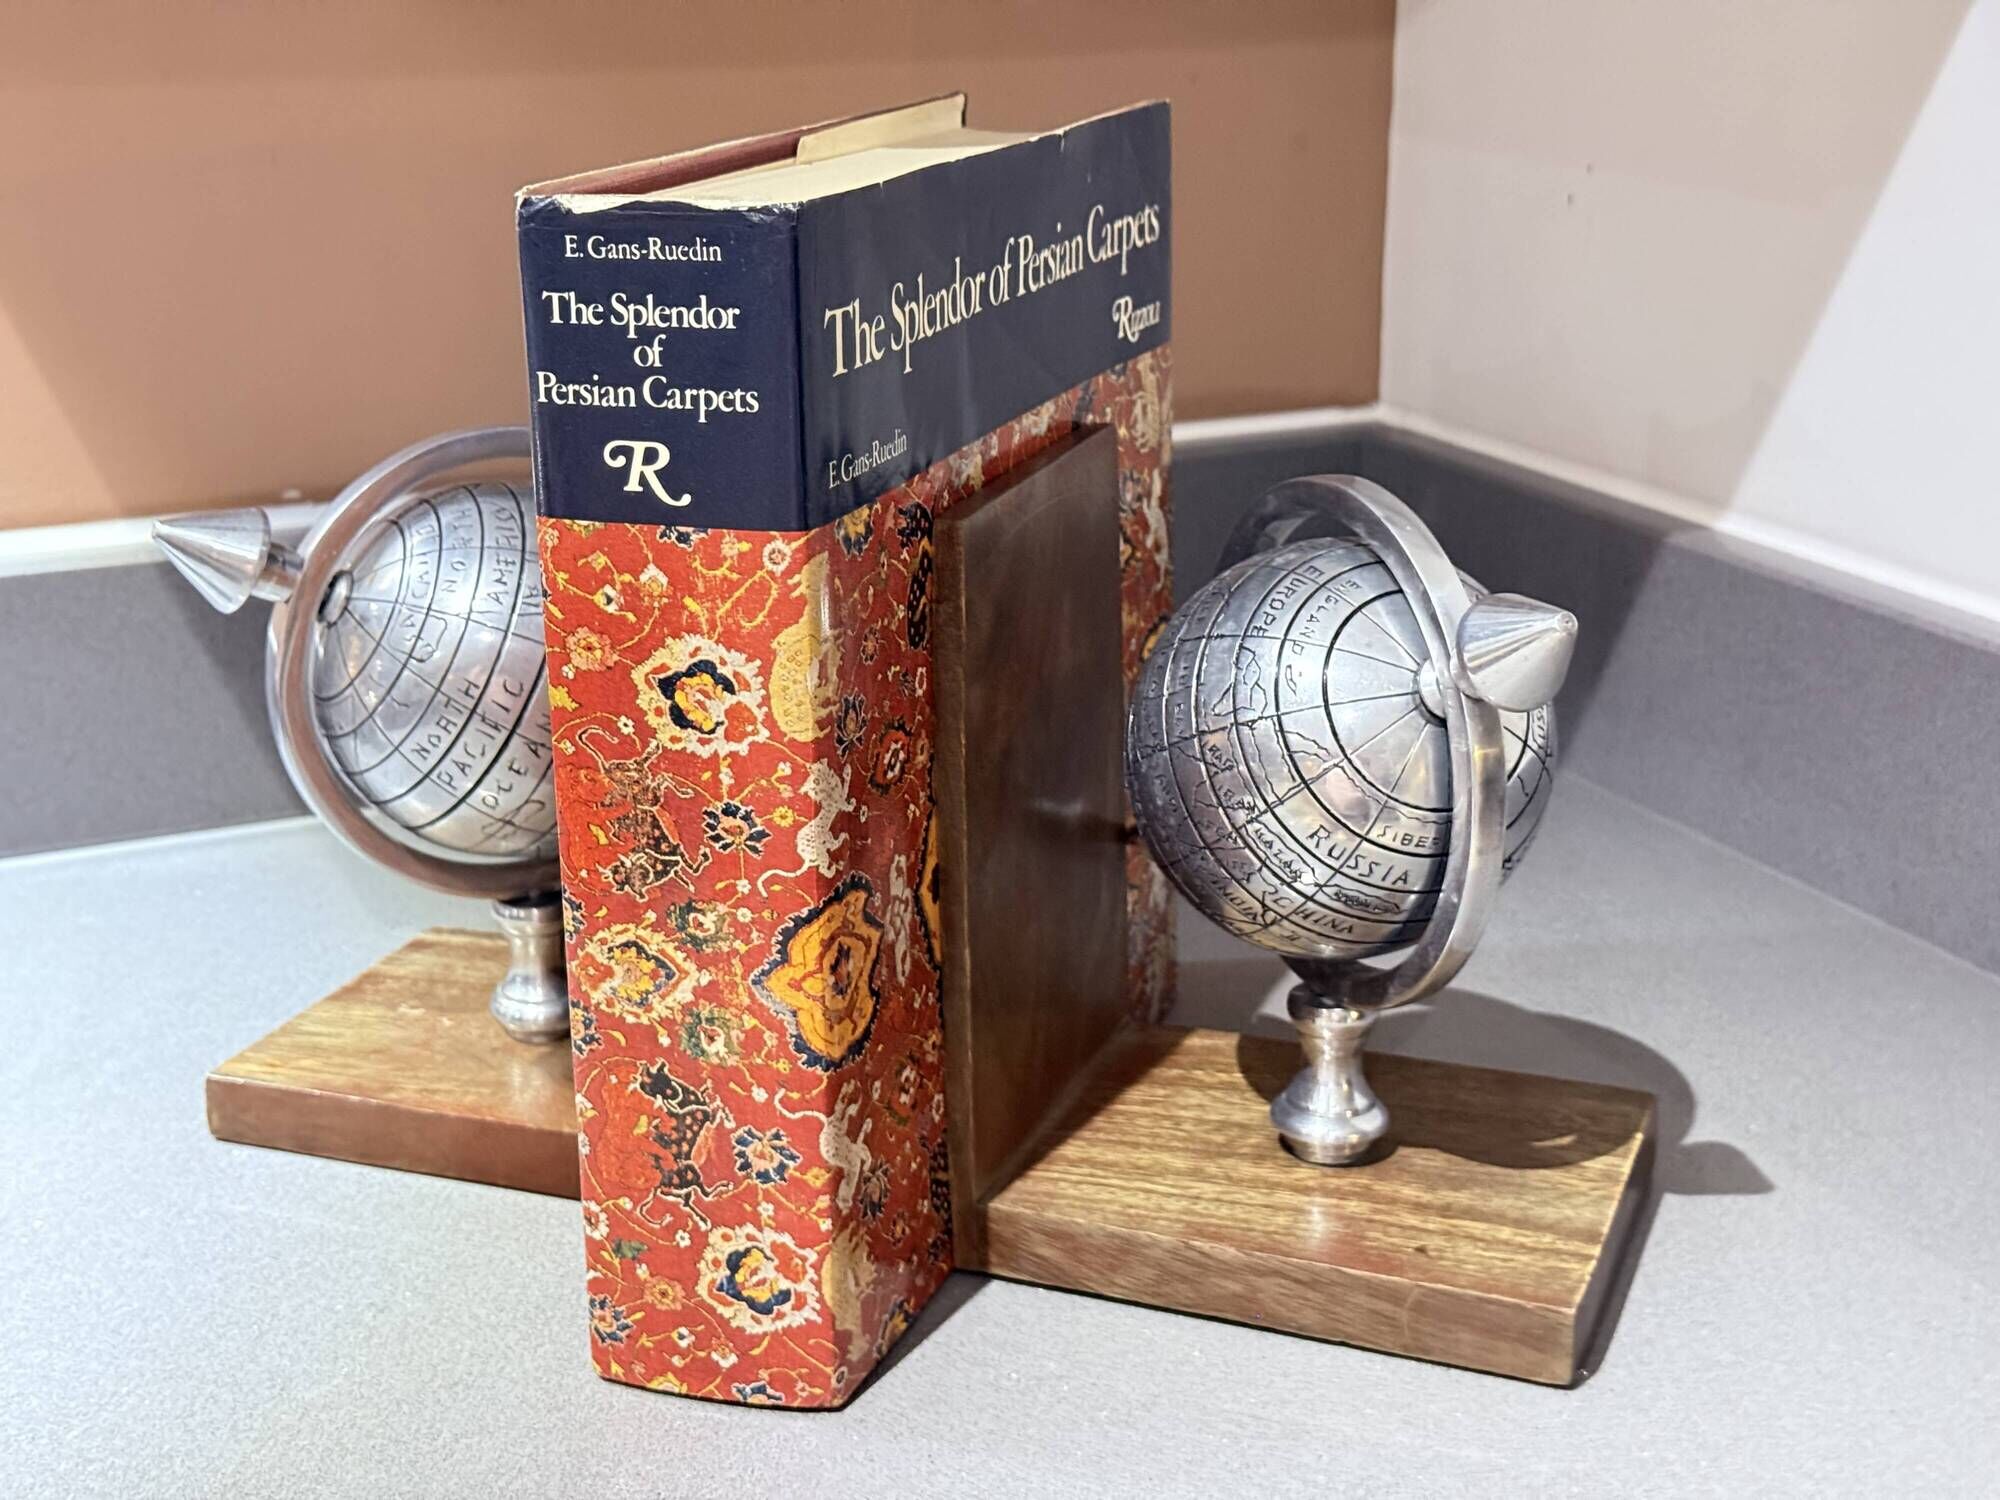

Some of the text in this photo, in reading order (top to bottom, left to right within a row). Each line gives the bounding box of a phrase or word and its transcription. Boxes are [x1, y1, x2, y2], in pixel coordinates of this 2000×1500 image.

[564, 235, 722, 262] E. Gans-Ruedin
[542, 290, 740, 339] The Splendor
[824, 204, 1160, 377] The Splendor of Persian Carpets
[633, 334, 666, 367] of
[536, 371, 759, 423] Persian Carpets
[603, 440, 692, 507] R
[829, 428, 907, 489] E. Gans-Ruedin
[1250, 565, 1326, 638] EUROPE
[410, 678, 480, 760] NORTH
[437, 679, 525, 790] PACIFIC
[1306, 824, 1409, 886] RUSSIA
[1272, 897, 1354, 934] CHINA
